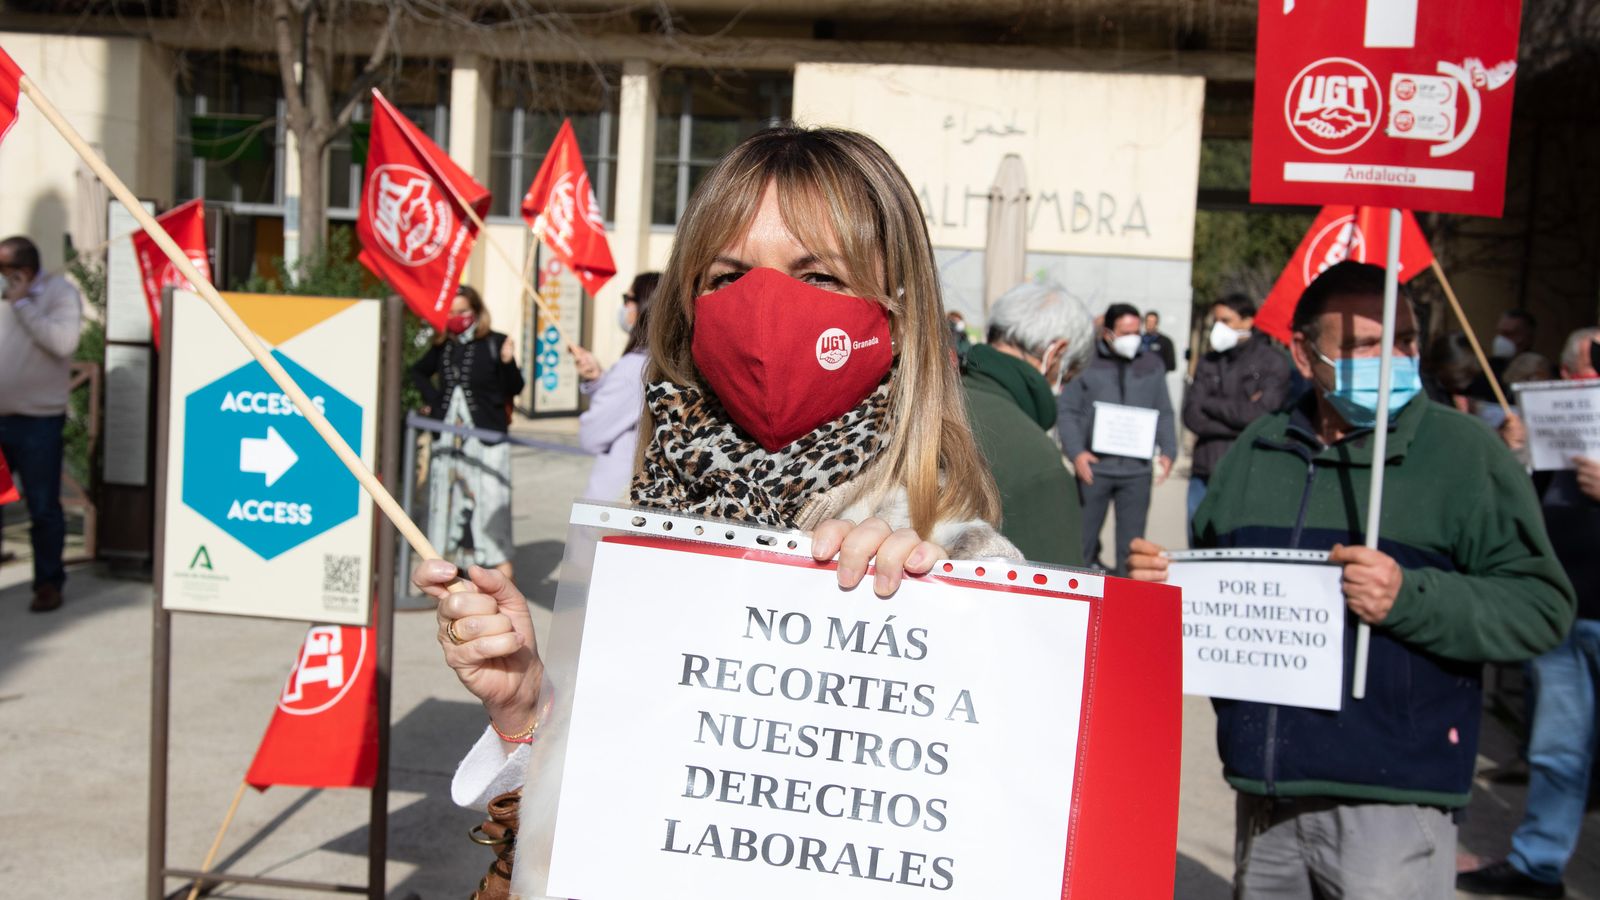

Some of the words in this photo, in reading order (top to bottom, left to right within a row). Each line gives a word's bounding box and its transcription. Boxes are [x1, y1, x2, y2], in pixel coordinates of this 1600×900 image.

[1299, 75, 1369, 111] UGT
[1343, 166, 1417, 184] Andalucía
[917, 182, 1151, 238] ALHMBRA
[820, 335, 846, 353] UGT
[853, 336, 879, 350] Granada
[227, 499, 313, 525] ACCESS
[1219, 579, 1257, 597] POR
[1263, 581, 1287, 598] EL
[741, 605, 812, 645] NO
[823, 614, 929, 661] MÁS
[1182, 623, 1217, 639] DEL
[1225, 625, 1328, 649] CONVENIO
[1197, 646, 1308, 671] COLECTIVO
[677, 652, 936, 718] RECORTES
[945, 688, 980, 724] A
[693, 709, 950, 776] NUESTROS
[681, 763, 948, 833] DERECHOS
[660, 817, 955, 891] LABORALES
